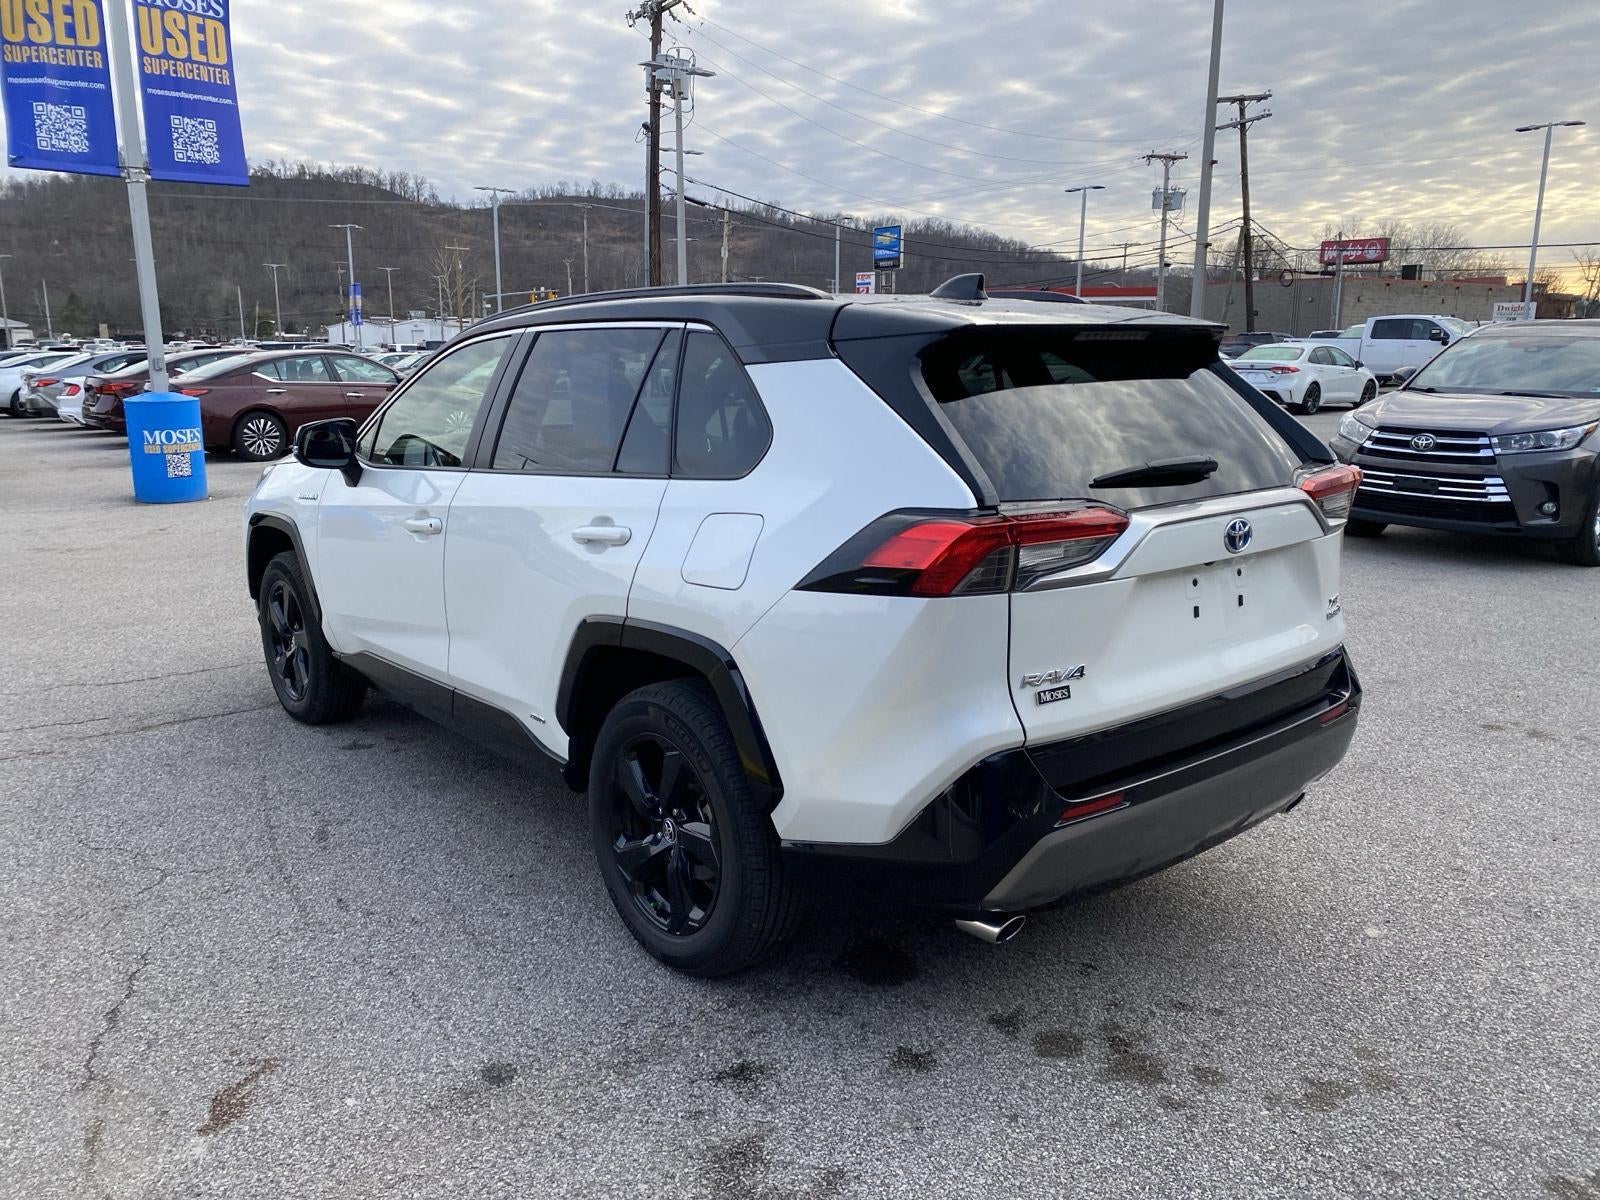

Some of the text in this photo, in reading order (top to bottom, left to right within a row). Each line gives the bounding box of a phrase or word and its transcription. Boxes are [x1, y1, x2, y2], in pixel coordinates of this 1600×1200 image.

[138, 0, 225, 18] SES
[1, 0, 100, 47] USED
[137, 5, 228, 65] USED
[4, 44, 103, 69] SUPERCENTER
[143, 56, 230, 86] SUPERCENTER
[7, 76, 105, 90] mosesusedsupercenter.com
[1324, 243, 1363, 260] Wedy's
[142, 428, 201, 445] MOSES
[1020, 663, 1086, 689] RAV4
[1039, 689, 1069, 703] MOSES
